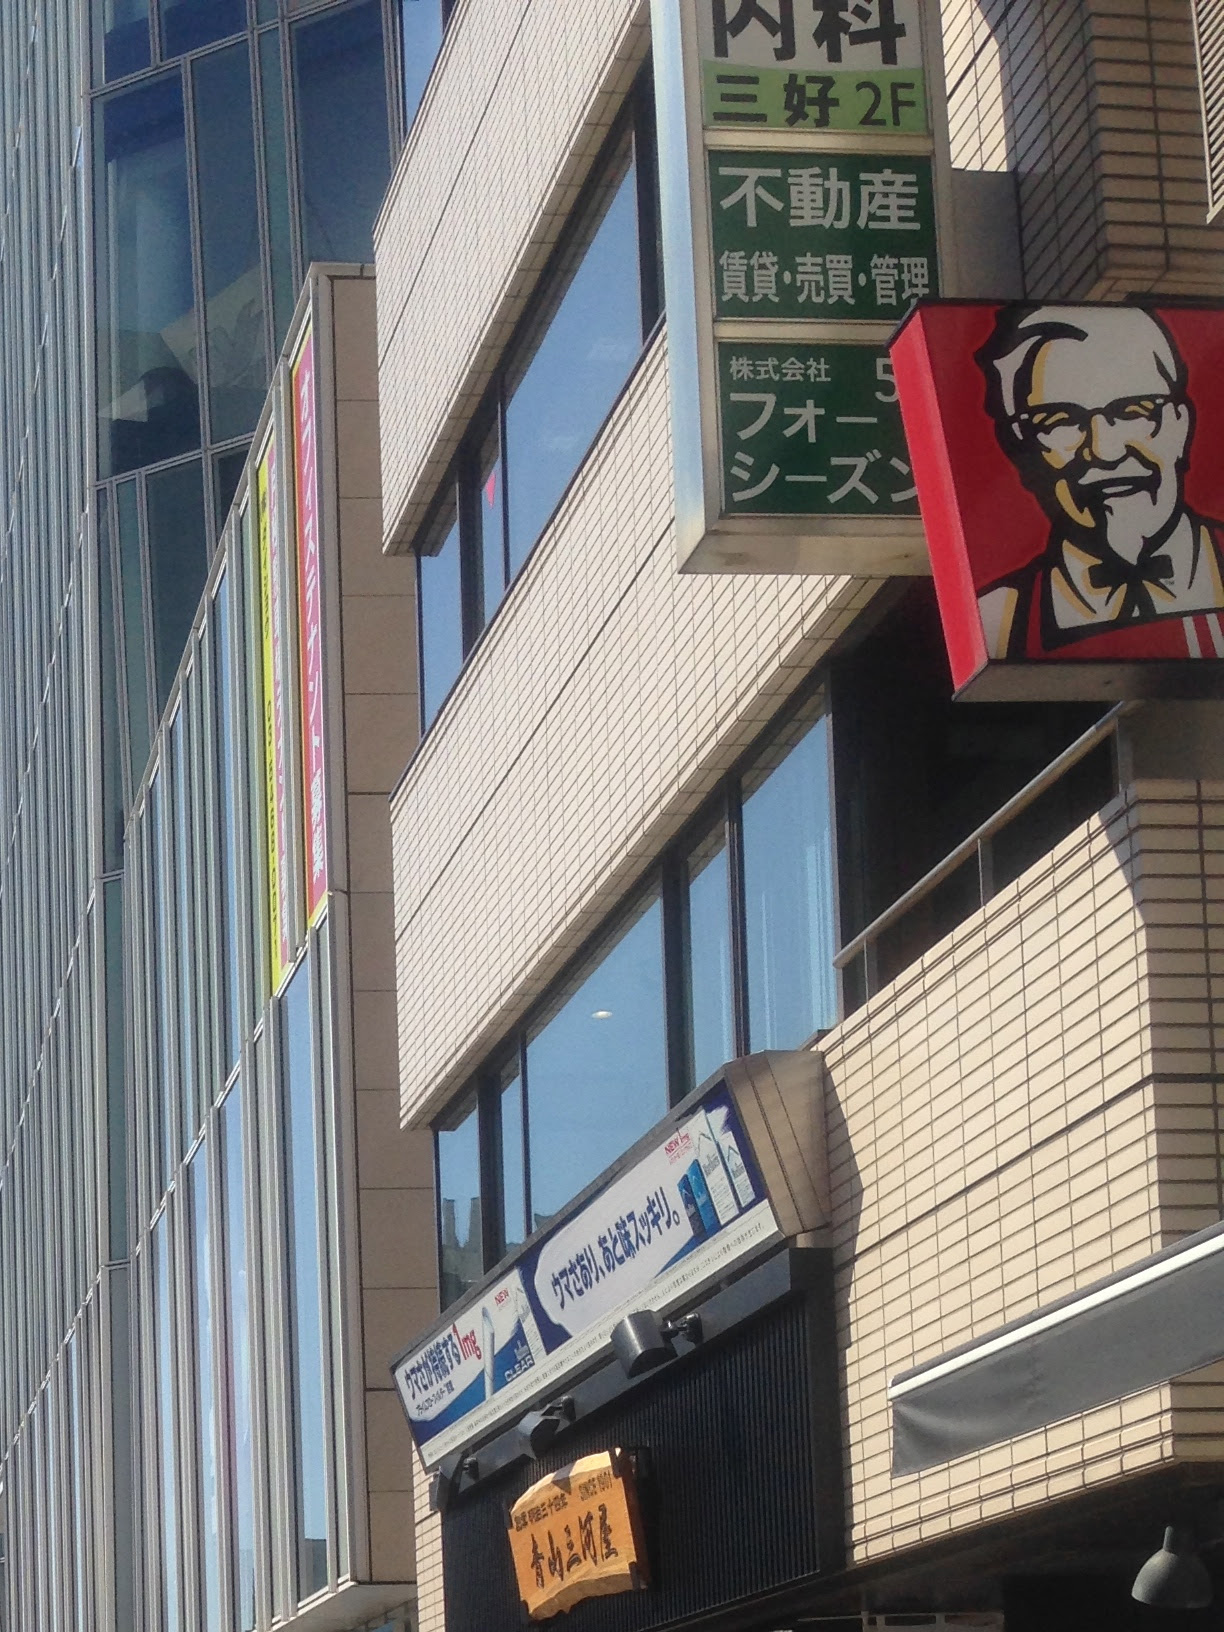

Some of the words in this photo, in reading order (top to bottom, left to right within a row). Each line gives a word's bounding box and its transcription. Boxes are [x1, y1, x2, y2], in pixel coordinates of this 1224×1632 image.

[712, 74, 839, 126] 三好
[854, 80, 917, 127] 2F
[718, 166, 922, 231] 不動産
[718, 249, 930, 306] 賃貸・売買・管理
[728, 355, 832, 384] 株式会社
[732, 391, 879, 444] フォー
[551, 1186, 680, 1309] ウマさあり、あと味スッキリ。
[504, 1355, 535, 1382] CLEAR
[530, 1503, 618, 1589] 青山三河屋
